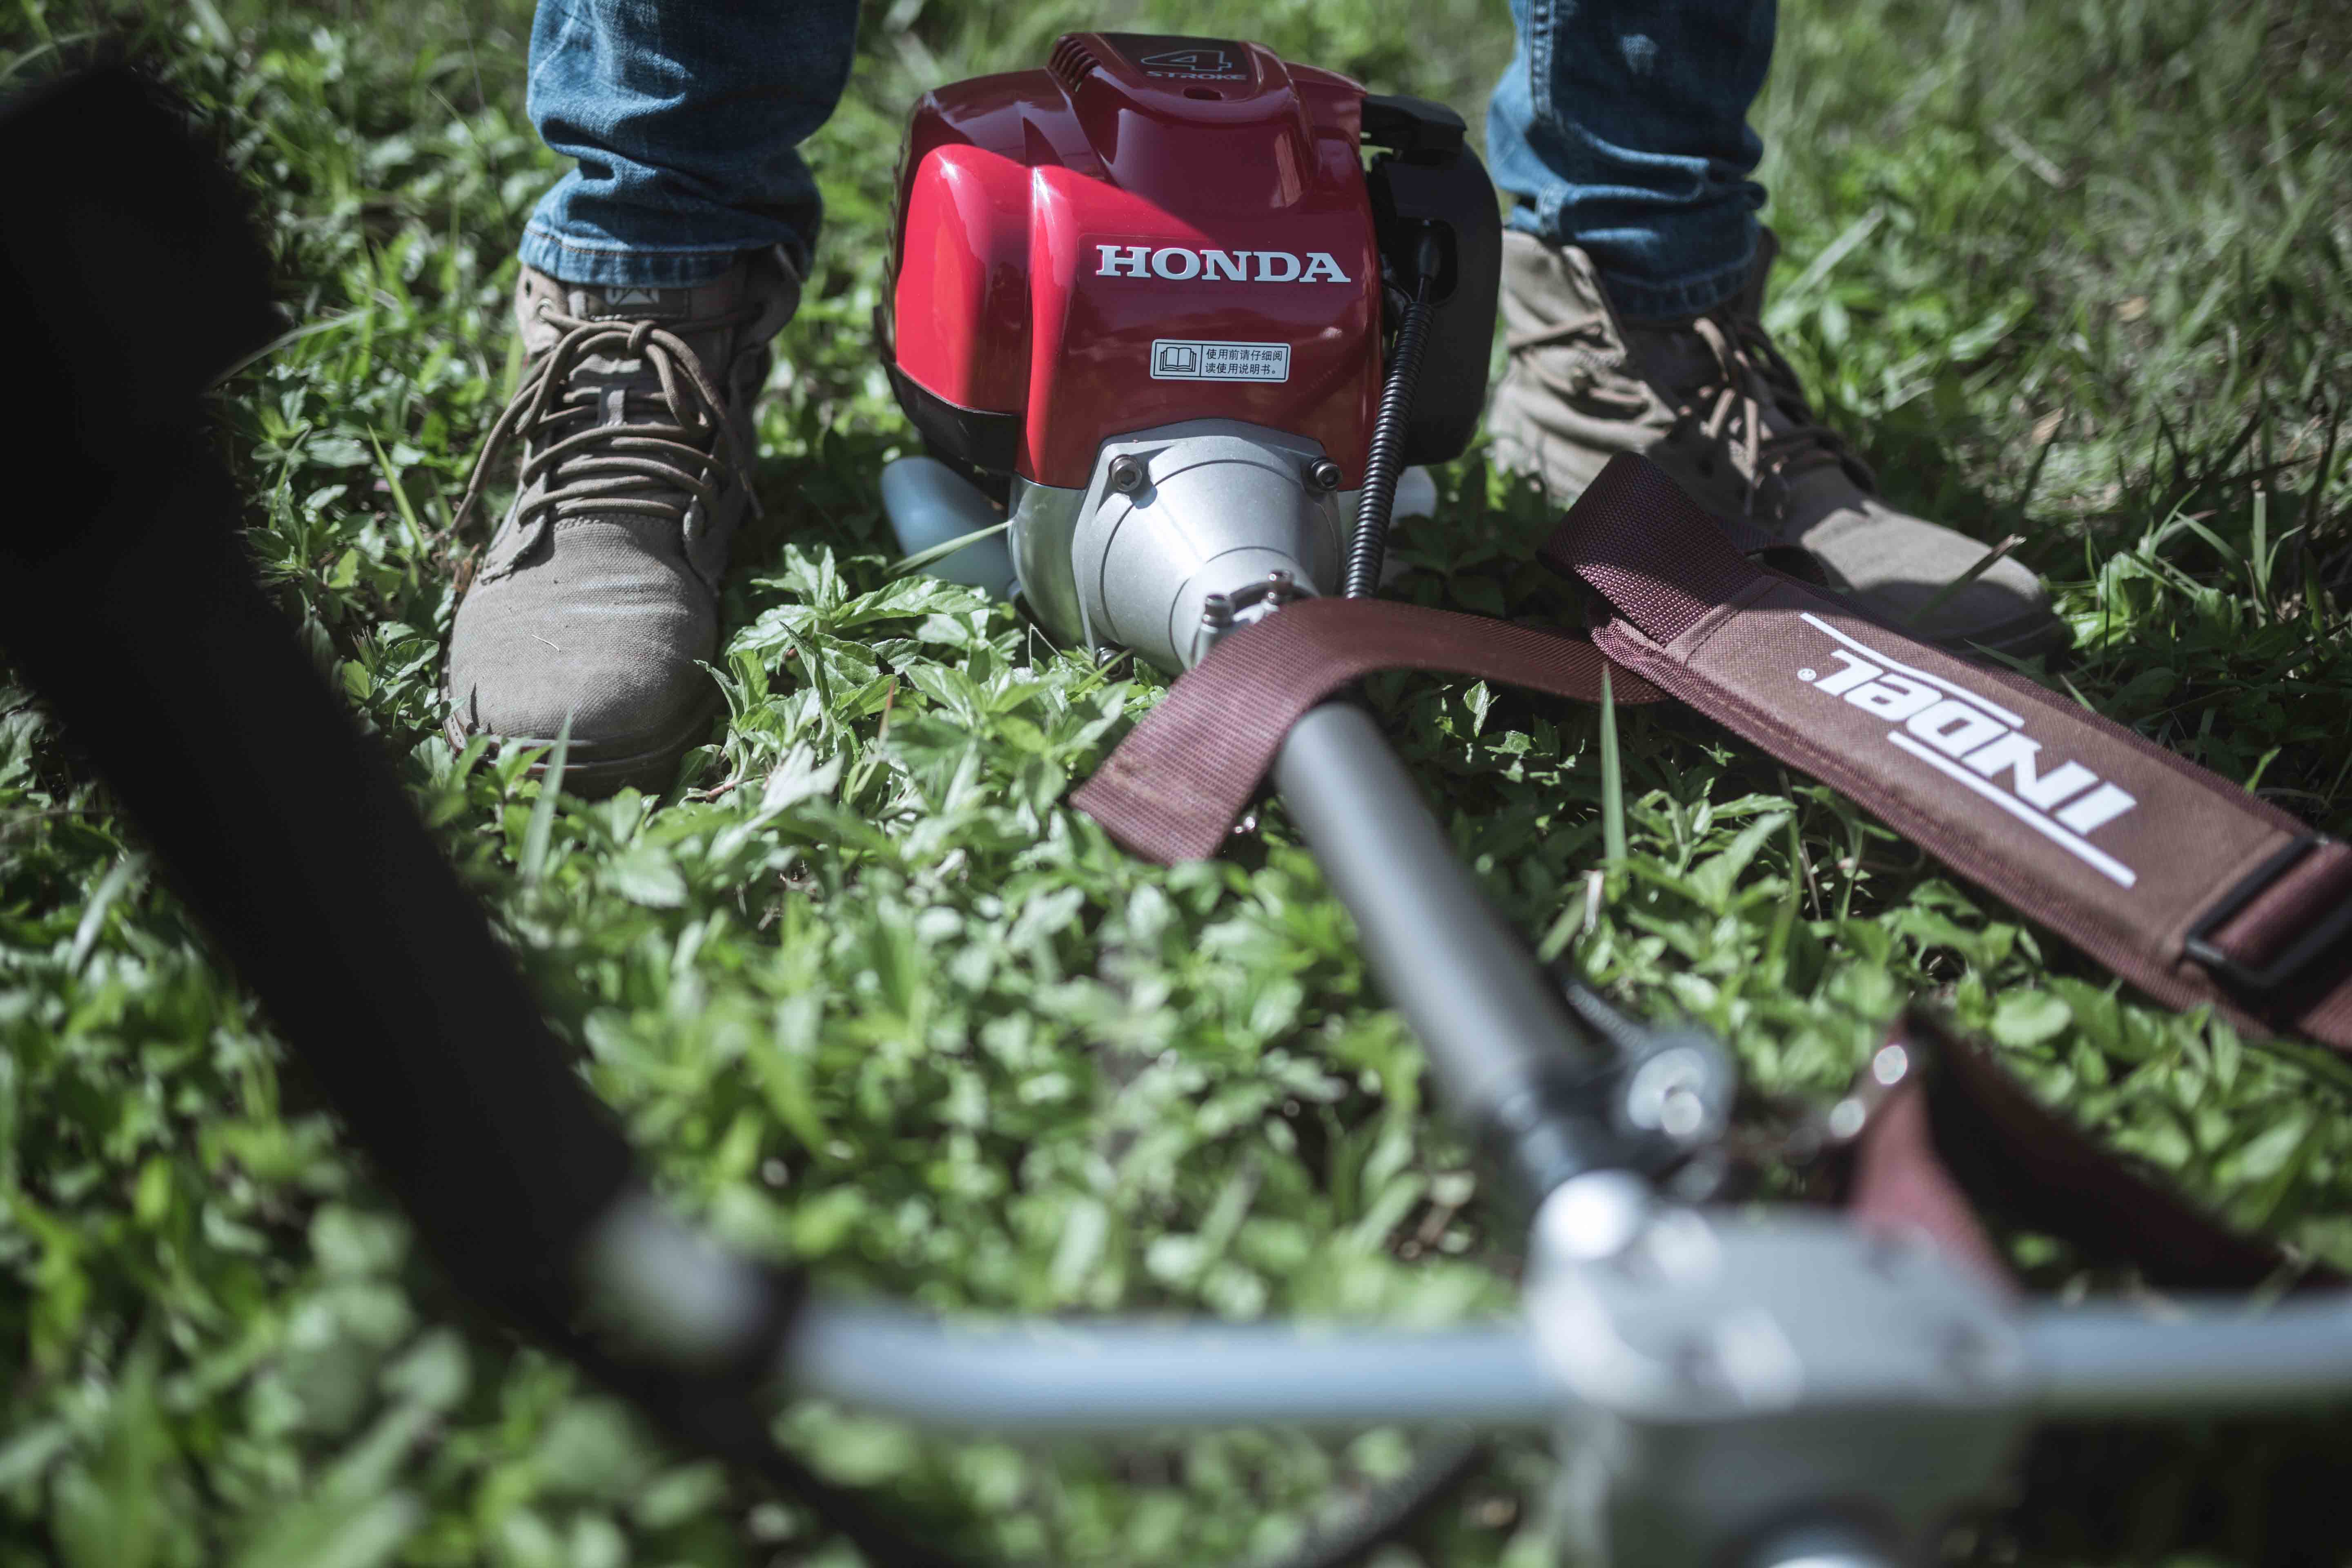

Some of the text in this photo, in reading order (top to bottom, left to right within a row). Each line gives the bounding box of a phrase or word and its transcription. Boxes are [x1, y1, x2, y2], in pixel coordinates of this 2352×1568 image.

[1140, 50, 1232, 71] 4
[1146, 71, 1246, 80] STROKE
[1096, 245, 1351, 283] HONDA
[1206, 348, 1283, 361] 使用前请仔细阅
[1205, 362, 1276, 375] 读使用说明书。
